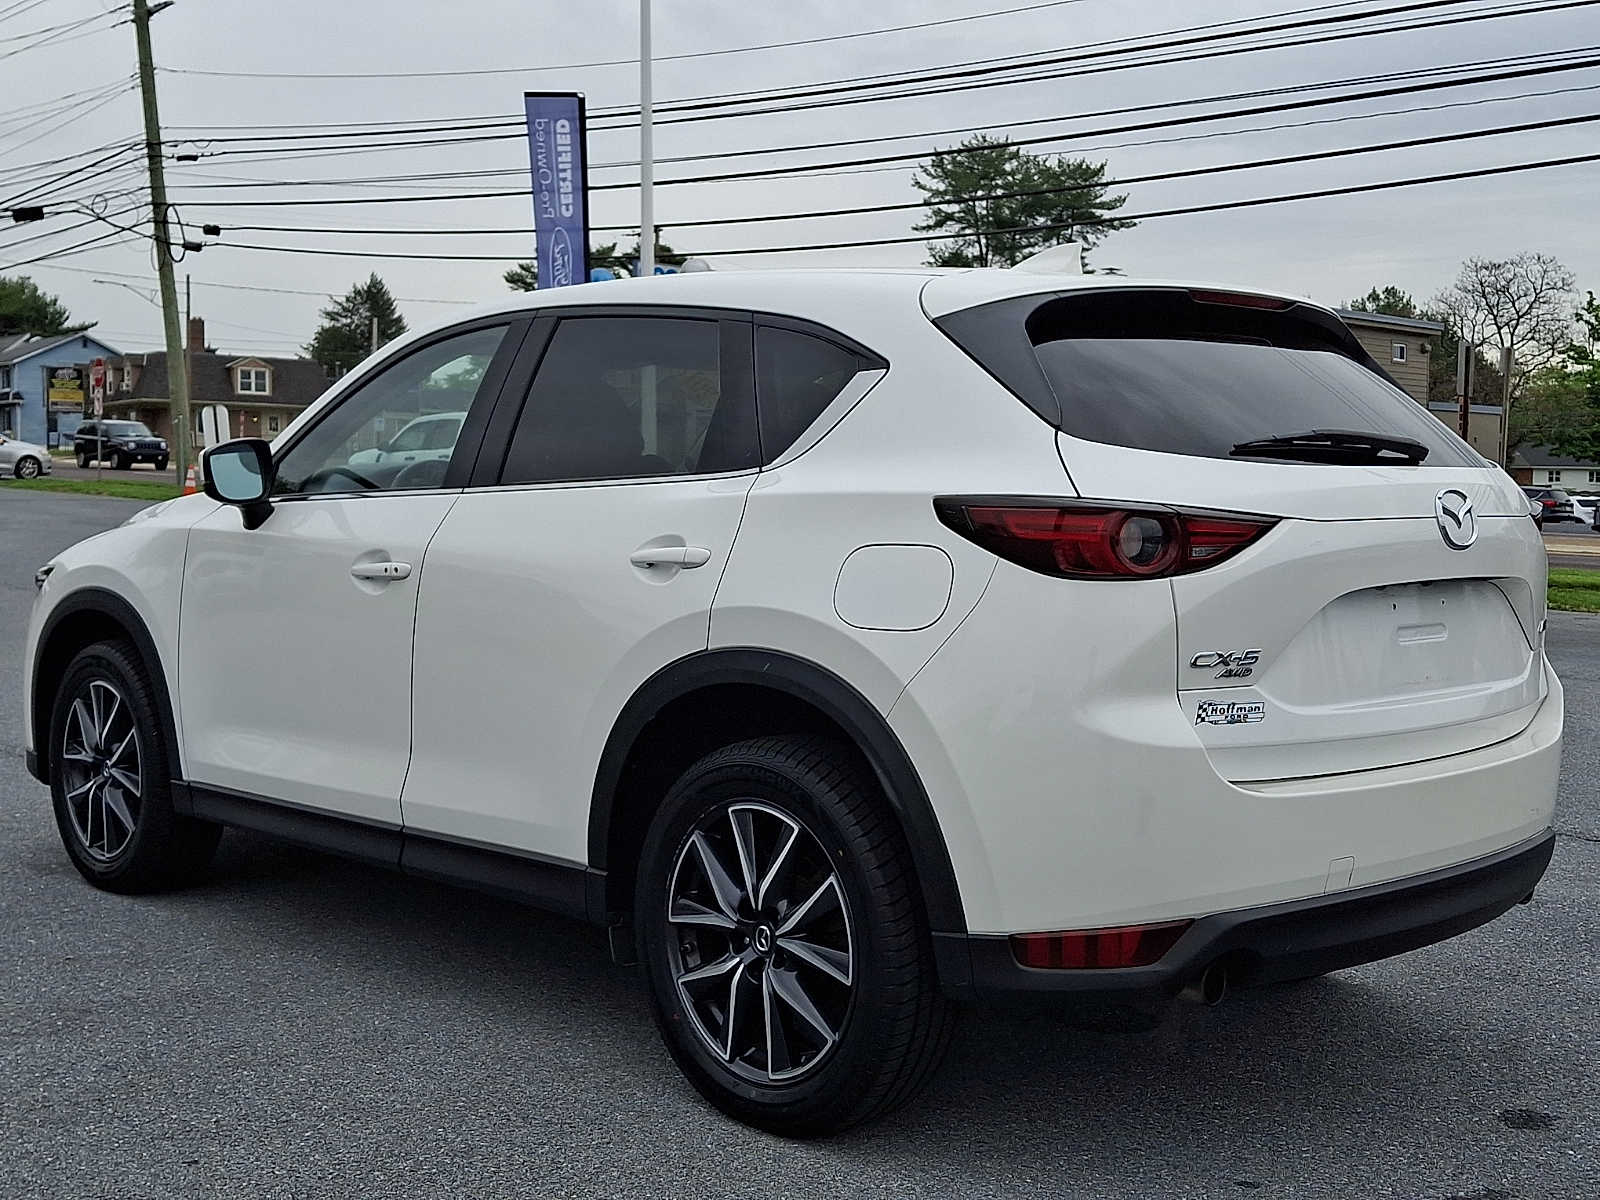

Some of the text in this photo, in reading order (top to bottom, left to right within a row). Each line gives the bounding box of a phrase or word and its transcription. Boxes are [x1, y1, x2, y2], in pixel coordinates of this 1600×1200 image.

[1190, 648, 1262, 668] CX-5
[1214, 666, 1253, 679] AWD
[1210, 702, 1261, 715] Hoffman
